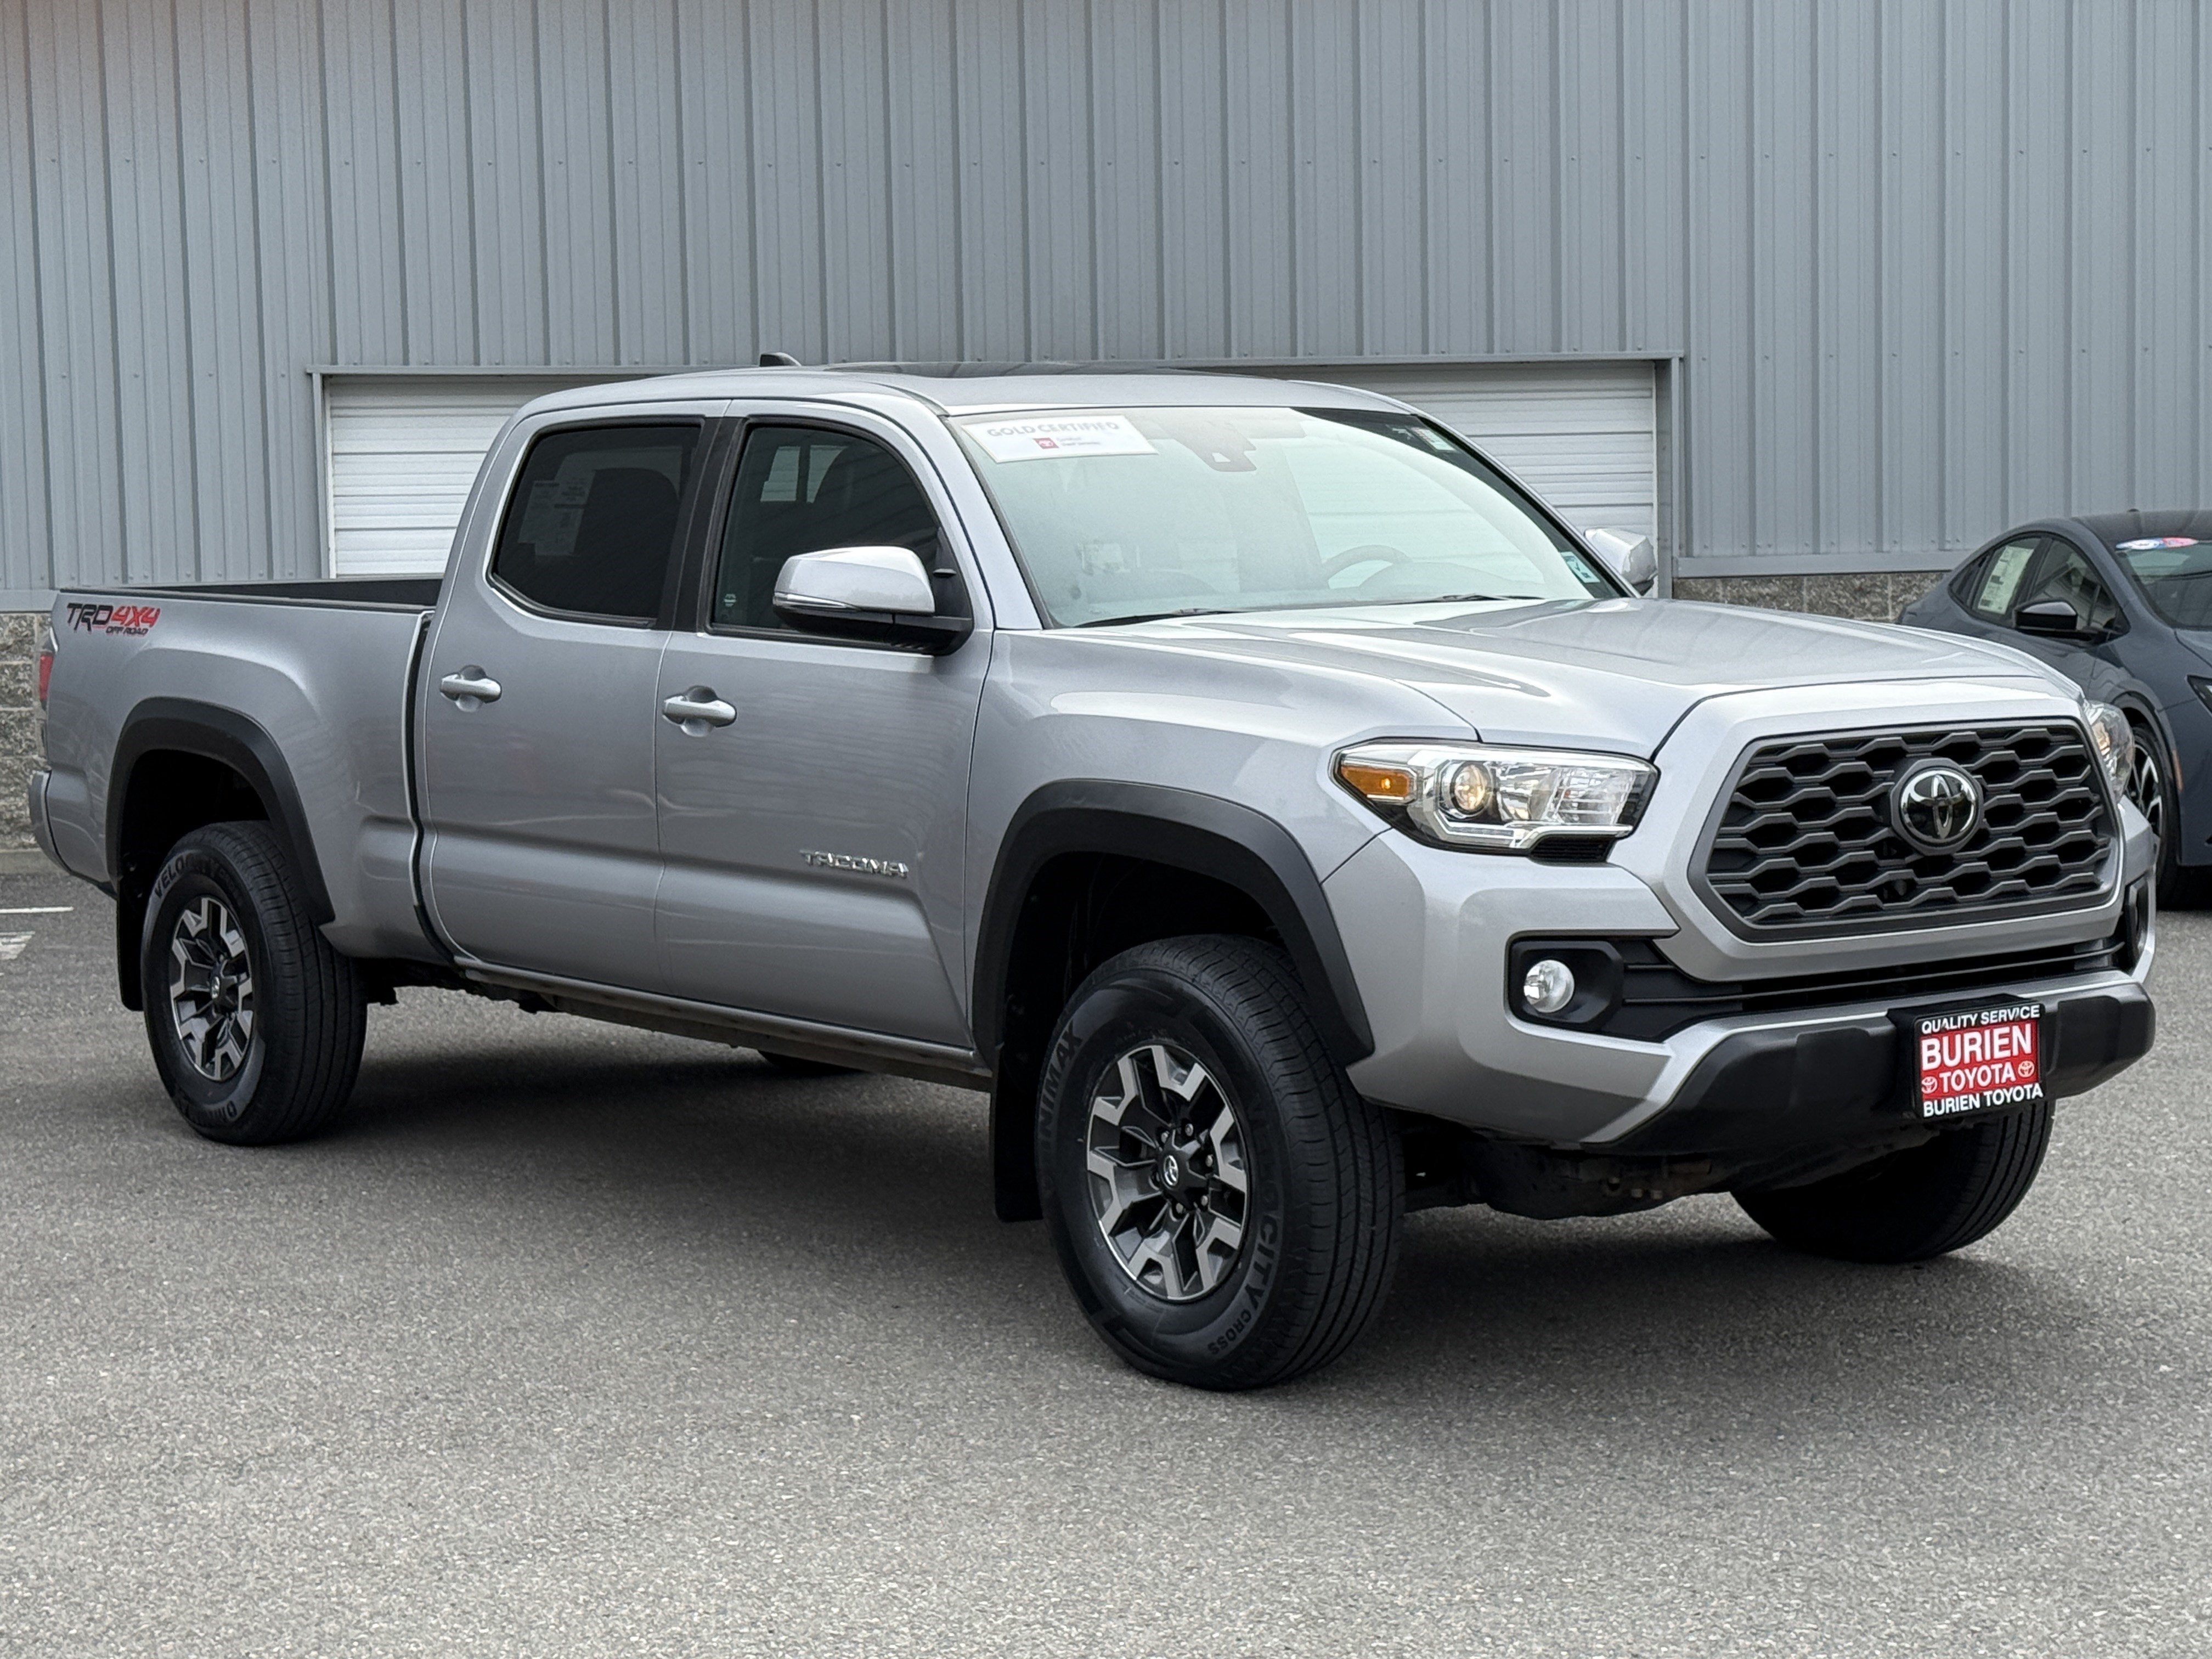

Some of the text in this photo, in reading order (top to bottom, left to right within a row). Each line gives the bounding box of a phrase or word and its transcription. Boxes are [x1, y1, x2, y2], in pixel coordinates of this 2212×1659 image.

[987, 421, 1120, 437] GOLD CERTIFIED
[66, 603, 114, 634] TRD
[799, 850, 909, 878] TACOMA
[1922, 1005, 2040, 1034] QUALITY SERVICE
[1921, 1023, 2032, 1070] BURIEN
[1939, 1062, 2016, 1093] TOYOTA
[1923, 1083, 2043, 1117] BURIEN TOYOTA
[1207, 1308, 1252, 1356] CROSS
